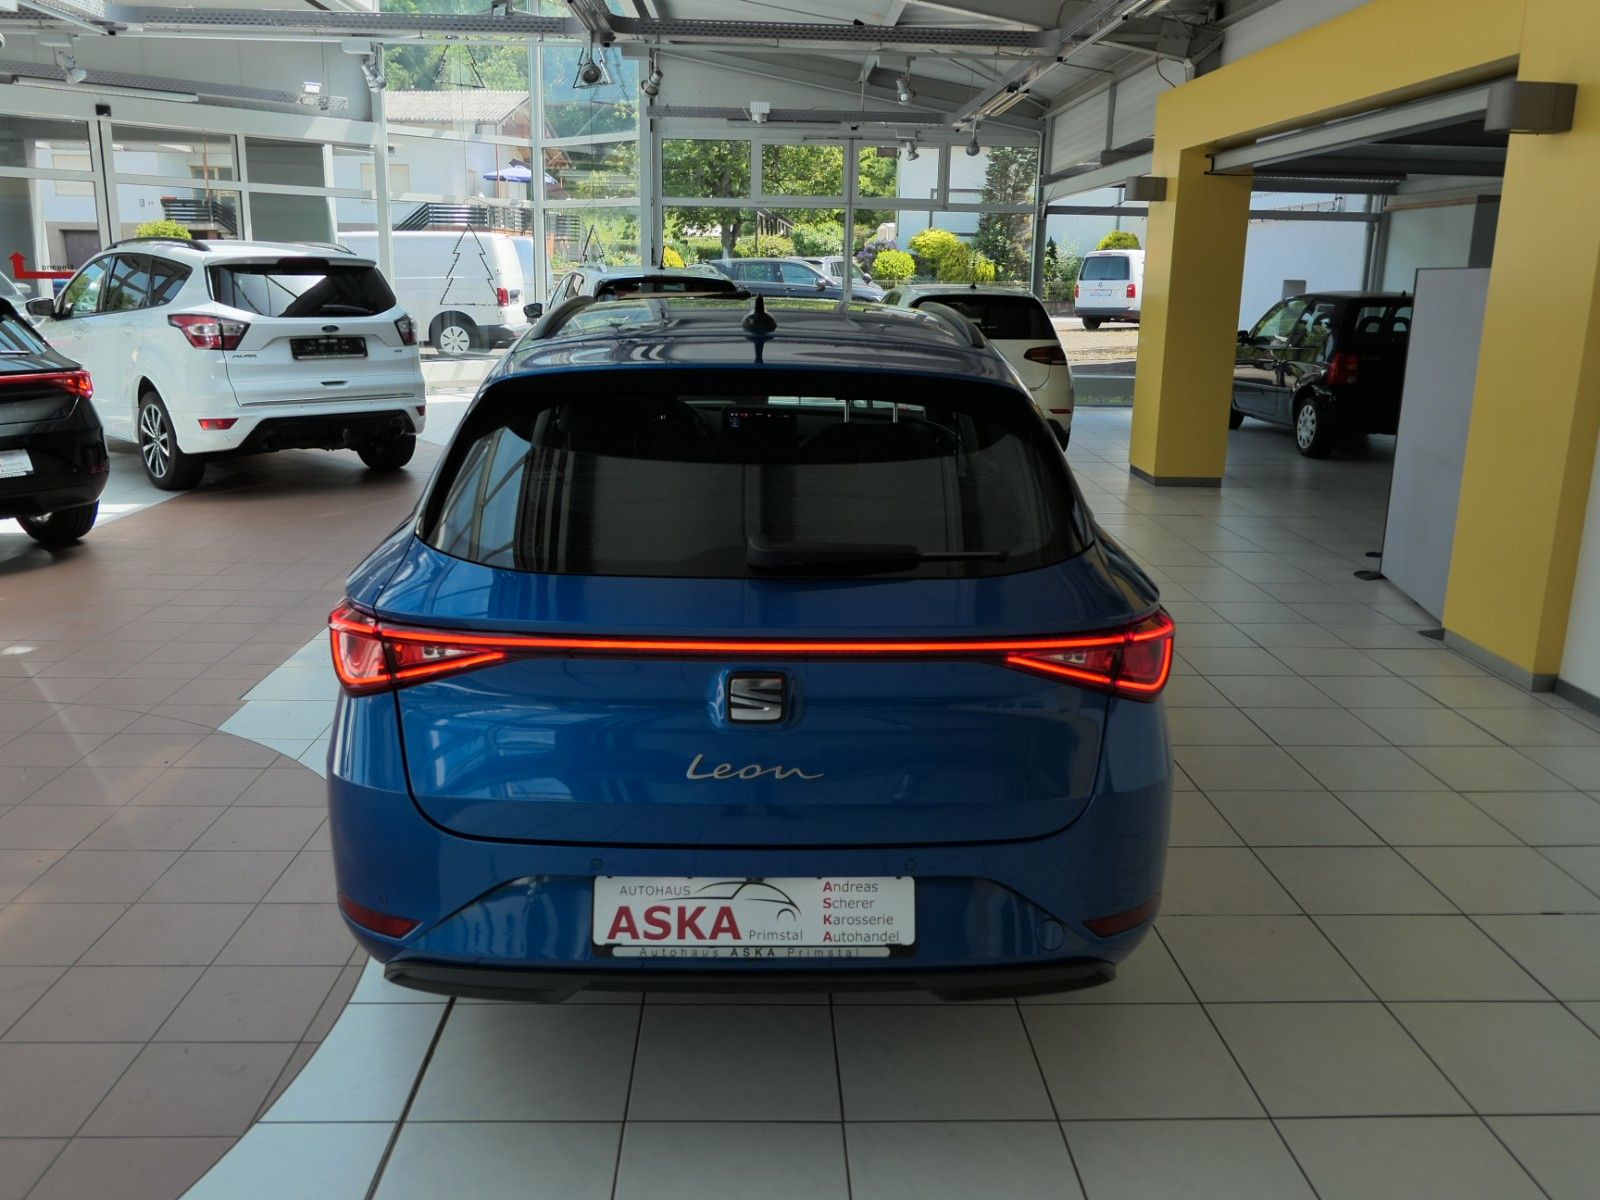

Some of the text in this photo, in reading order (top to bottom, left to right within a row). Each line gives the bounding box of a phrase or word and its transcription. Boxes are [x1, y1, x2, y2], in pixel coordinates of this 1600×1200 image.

[686, 753, 824, 780] Leon
[619, 885, 691, 897] AUTOHAUS
[822, 881, 879, 893] Andreas
[822, 897, 875, 909] Scherer
[607, 905, 803, 941] ASKA Primstal
[823, 914, 894, 925] Karosserie
[823, 930, 900, 943] Autohandel
[639, 947, 860, 957] Autohaus ASKA Primstal
